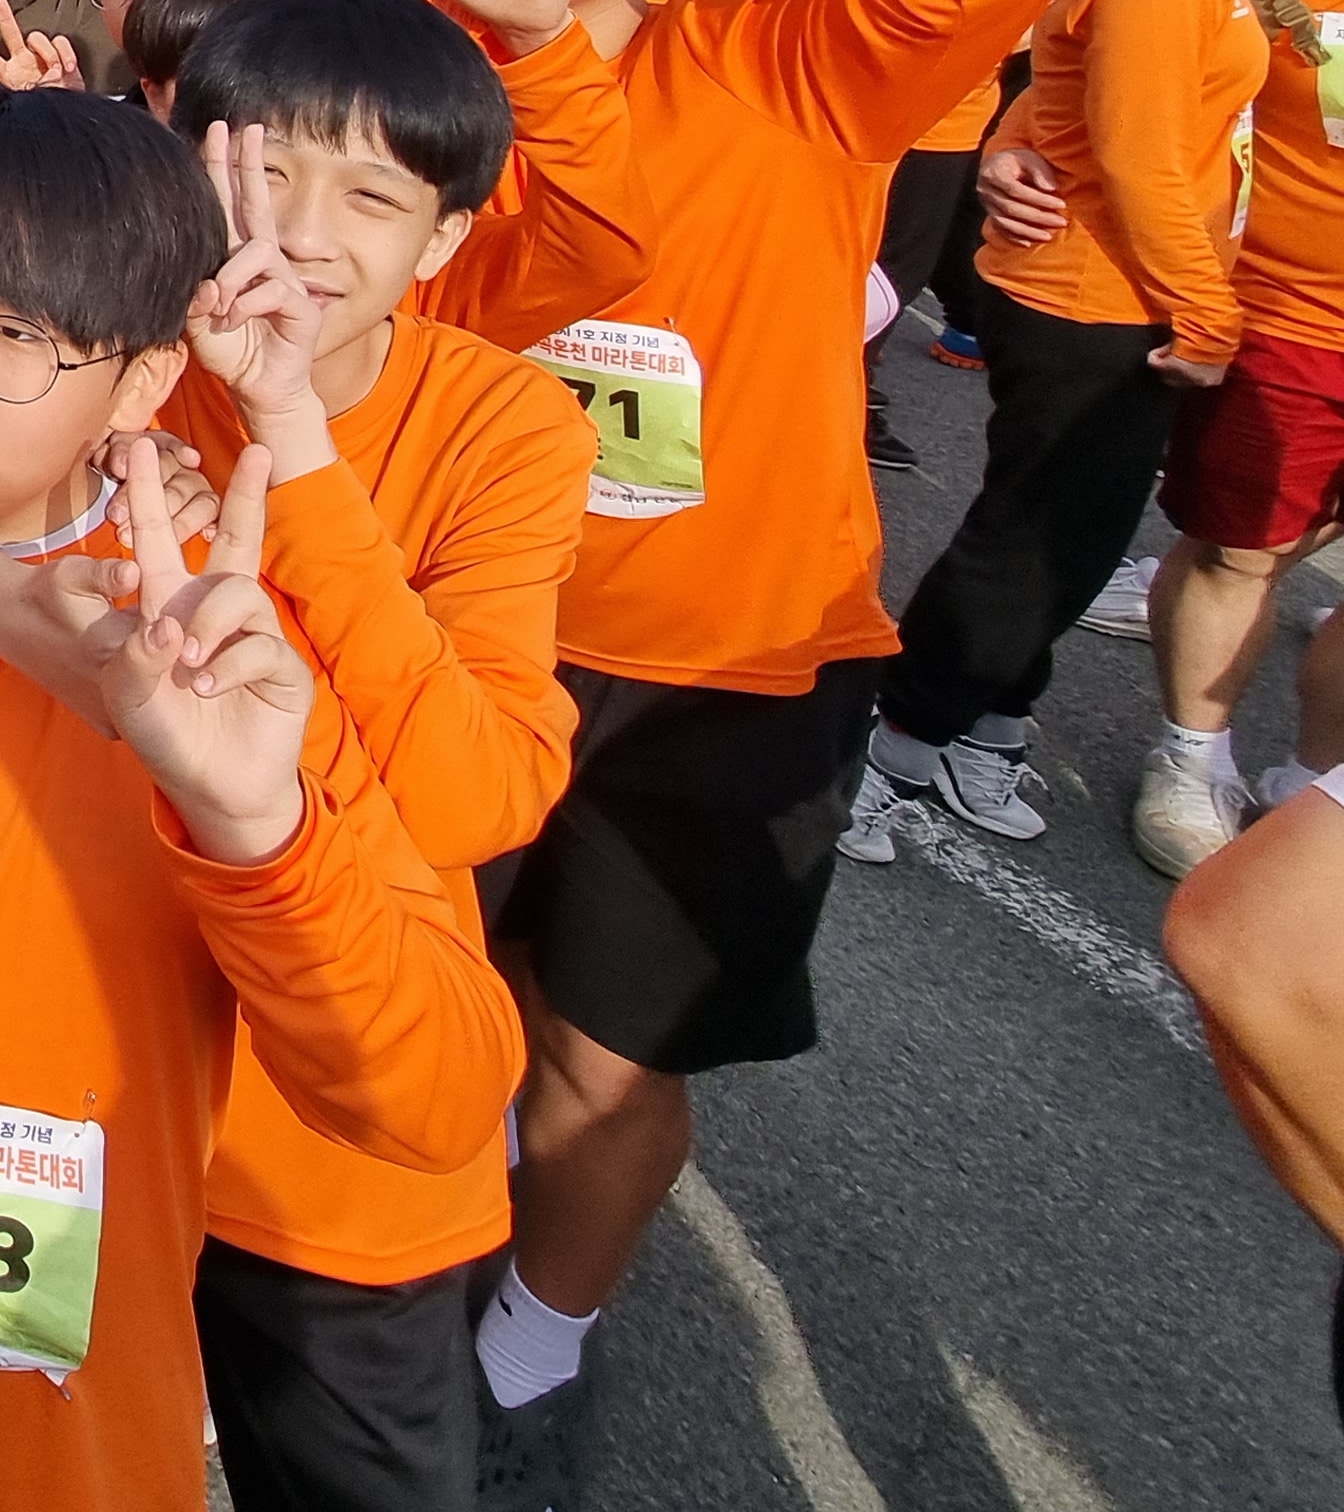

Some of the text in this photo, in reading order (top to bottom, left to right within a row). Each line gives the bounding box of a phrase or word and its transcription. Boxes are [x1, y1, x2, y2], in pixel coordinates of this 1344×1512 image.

[600, 330, 627, 345] 지정
[592, 346, 685, 376] 마라톤대회
[21, 1124, 53, 1145] 기념
